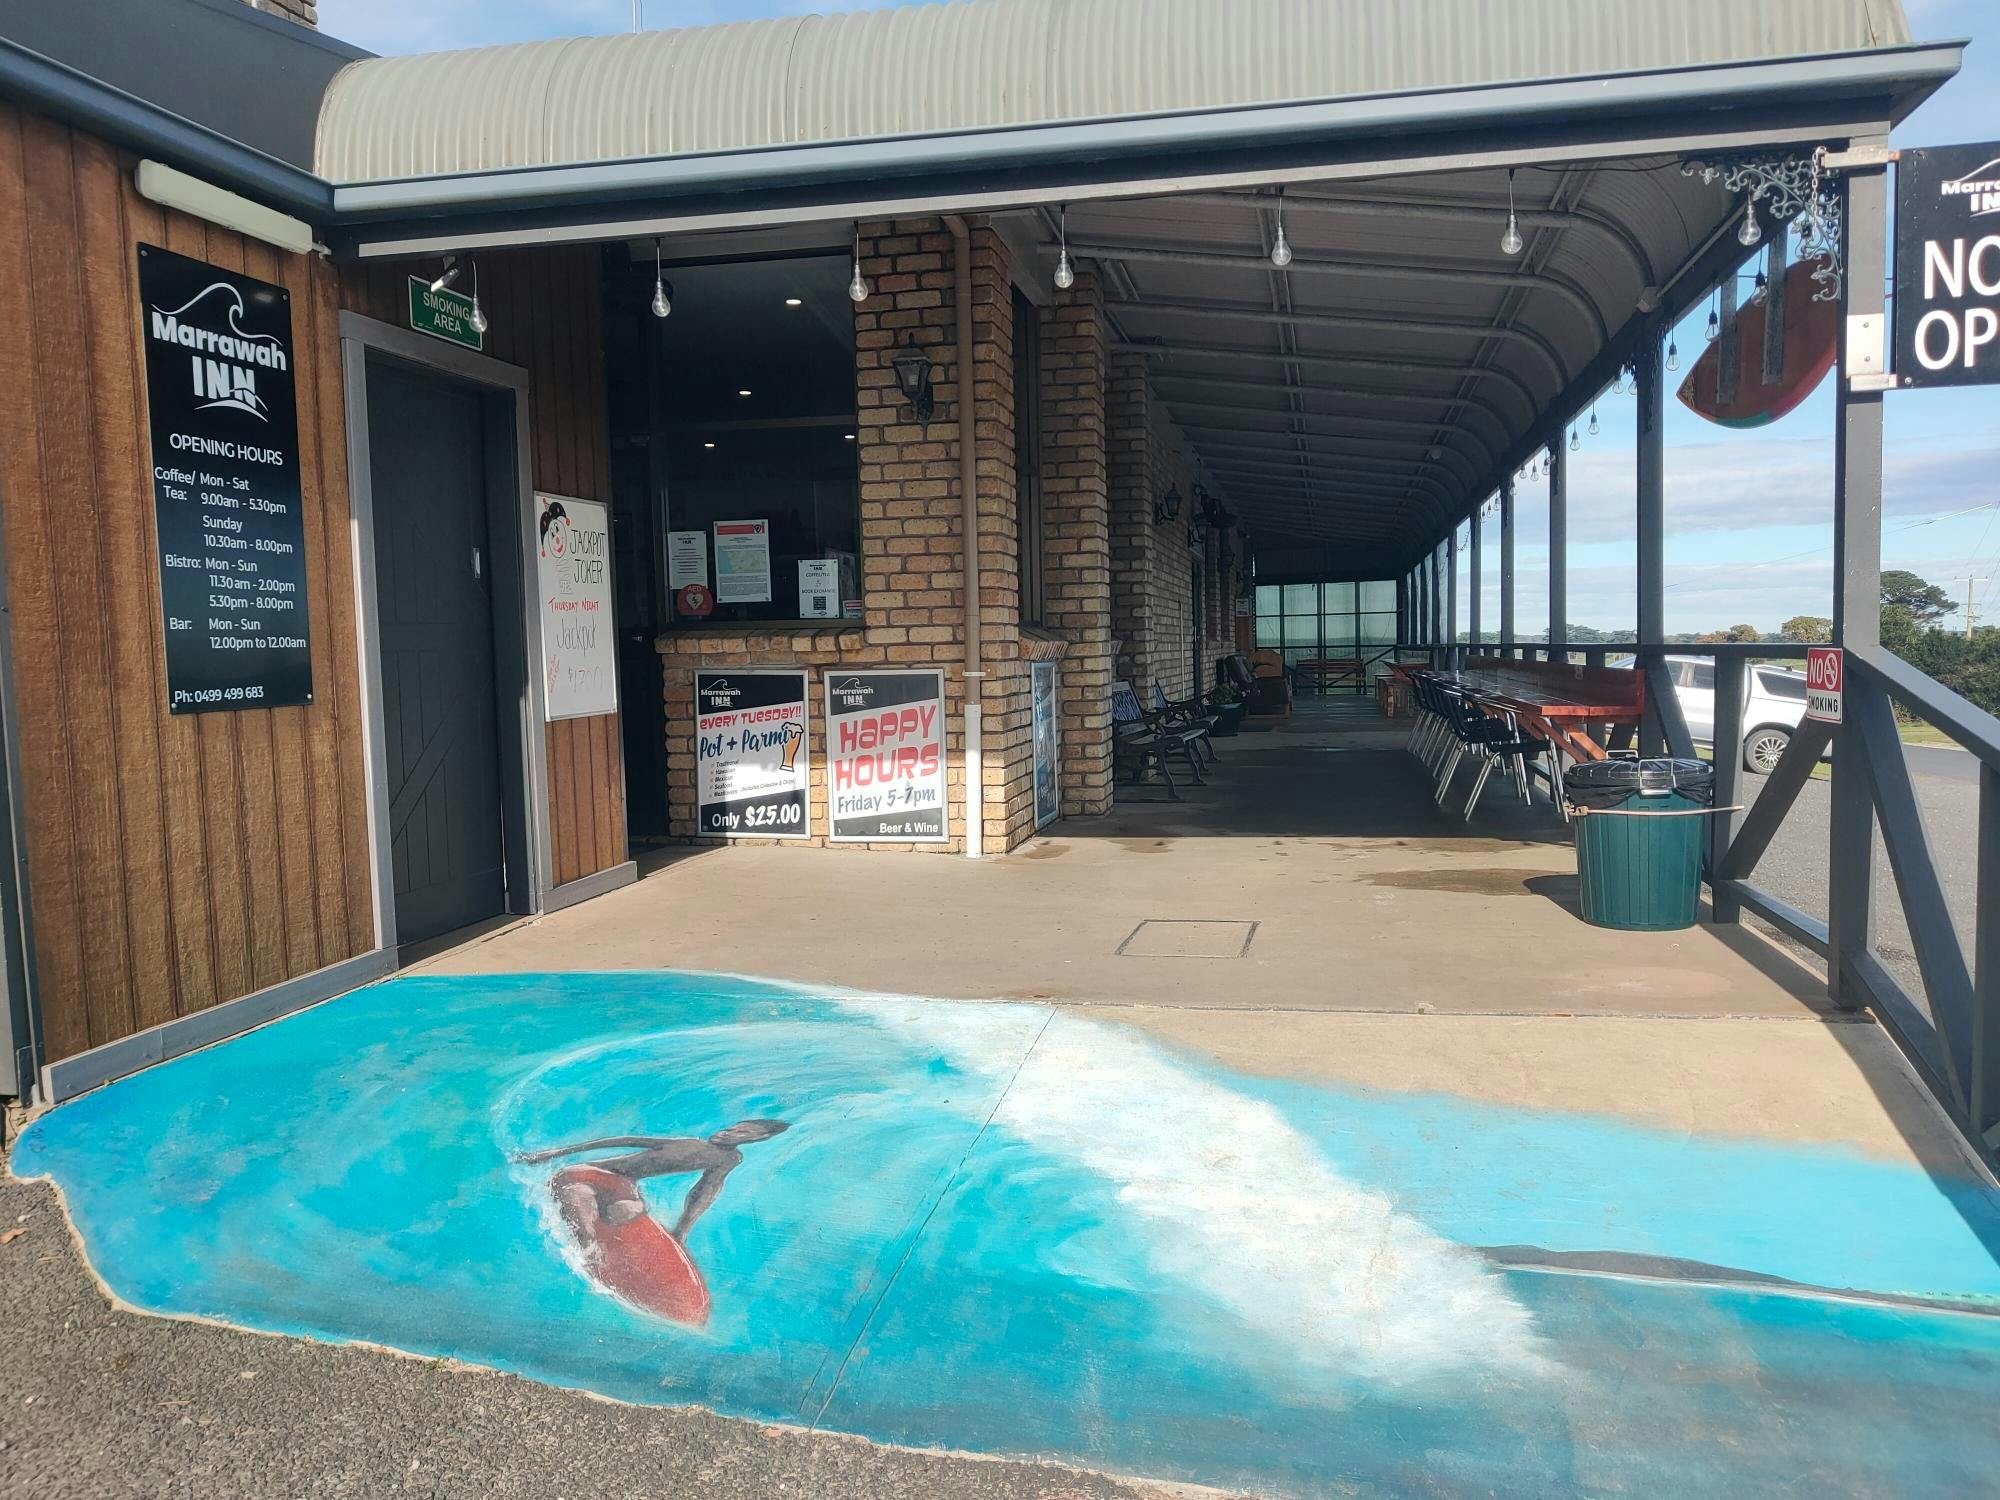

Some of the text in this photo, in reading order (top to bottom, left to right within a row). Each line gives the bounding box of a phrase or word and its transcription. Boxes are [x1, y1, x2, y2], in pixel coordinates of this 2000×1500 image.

[423, 292, 470, 320] SMOKING
[433, 312, 462, 334] AREA
[152, 311, 287, 370] Marrawah
[1914, 308, 1998, 370] OP
[192, 356, 257, 409] INN
[170, 433, 283, 465] OPENING HOURS
[154, 467, 196, 485] Coffee/
[200, 473, 224, 487] Mon
[232, 477, 250, 491] Sat
[163, 485, 187, 501] Tea:
[201, 492, 239, 509] 9.00am
[249, 498, 286, 514] 5.30pm
[203, 515, 243, 533] Sunday
[204, 534, 247, 550] 10.30am
[255, 539, 293, 553] 8.00pm
[569, 529, 606, 557] JACKPOT
[165, 554, 201, 569] Bistro:
[205, 557, 229, 571] Mon
[237, 559, 258, 572] Sun
[573, 558, 604, 584] JOKER
[258, 580, 295, 593] 2.00pm
[209, 595, 249, 611] 5.30pm
[256, 597, 293, 610] 8.00pm
[169, 617, 192, 630] Bar:
[208, 618, 232, 630] Mon
[240, 618, 260, 630] Sun
[209, 636, 306, 651] 12.00pm to 12.00am
[1809, 657, 1824, 684] NO
[174, 686, 264, 704] Ph: 0499 499 683
[711, 696, 731, 706] INN
[832, 687, 874, 696] Marrawah
[843, 695, 863, 705] INN
[1808, 695, 1838, 713] SMOKING
[700, 733, 724, 761] Pot
[741, 727, 790, 754] Parmi
[834, 742, 939, 791] HOURS
[837, 795, 882, 813] Friday
[712, 803, 800, 830] Only $25.00
[879, 822, 938, 833] Beer & Wine
